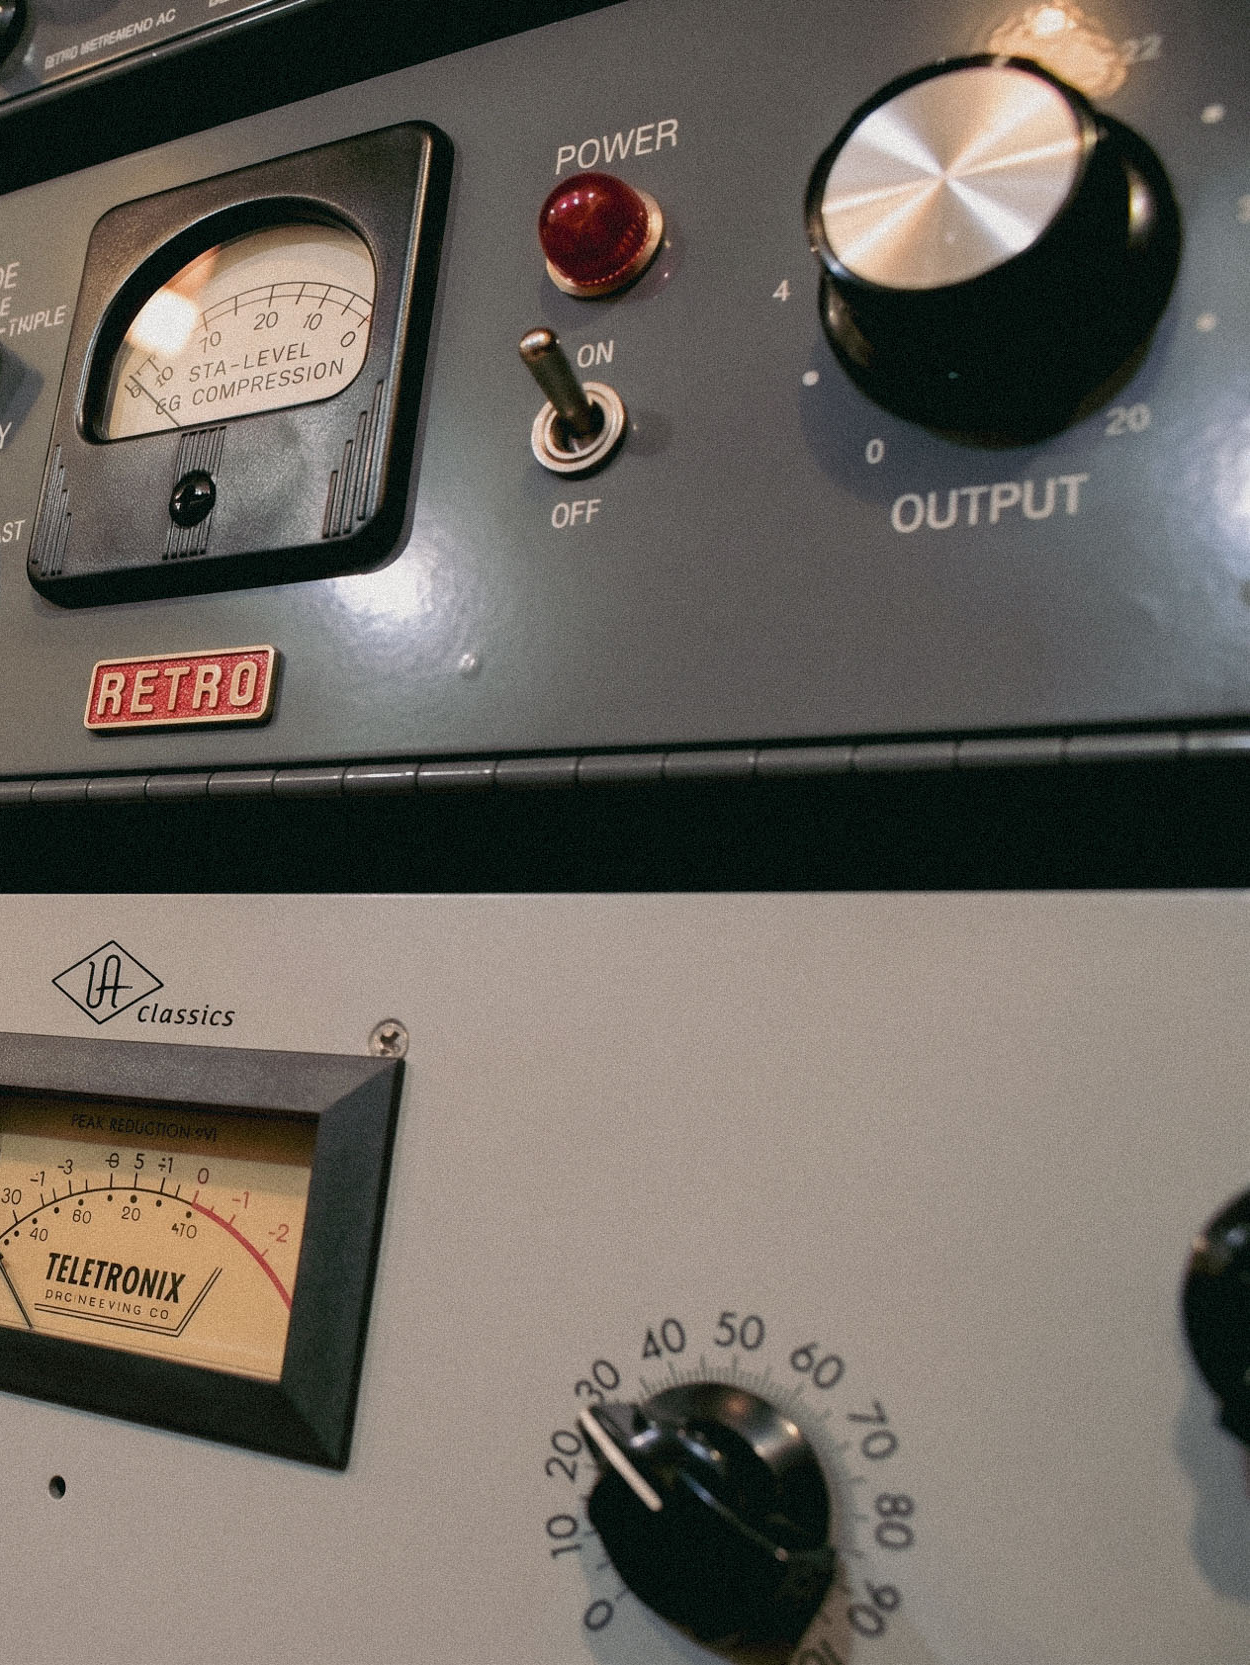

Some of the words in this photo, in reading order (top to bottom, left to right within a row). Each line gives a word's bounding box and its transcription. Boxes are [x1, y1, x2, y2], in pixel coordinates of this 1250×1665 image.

[555, 117, 679, 175] POWER
[772, 278, 792, 302] 4
[253, 311, 279, 331] 20
[301, 312, 323, 331] 10
[340, 331, 356, 348] 0
[188, 342, 310, 383] STA-LEVEL
[576, 340, 614, 369] ON
[192, 357, 345, 406] COMPRESSION
[1104, 403, 1151, 438] 20
[865, 438, 885, 465] 0
[551, 498, 603, 530] OFF
[890, 472, 1090, 534] OUTPUT
[96, 661, 258, 715] RETRO
[70, 1113, 104, 1131] PEAK
[109, 1117, 190, 1140] REDUCTION
[197, 1167, 210, 1185] 0
[121, 1206, 141, 1222] 20
[30, 1227, 48, 1242] 40
[268, 1223, 290, 1243] -2
[45, 1252, 186, 1303] TELETRONIX
[150, 1307, 169, 1320] CO
[714, 1312, 766, 1351] 50
[641, 1317, 686, 1360] 40
[574, 1359, 620, 1405] 30
[790, 1342, 845, 1390] 60
[846, 1400, 898, 1462] 70
[546, 1430, 583, 1483] 20
[546, 1514, 583, 1559] 10
[875, 1493, 914, 1551] 80
[583, 1599, 614, 1632] 0
[847, 1581, 901, 1638] 90
